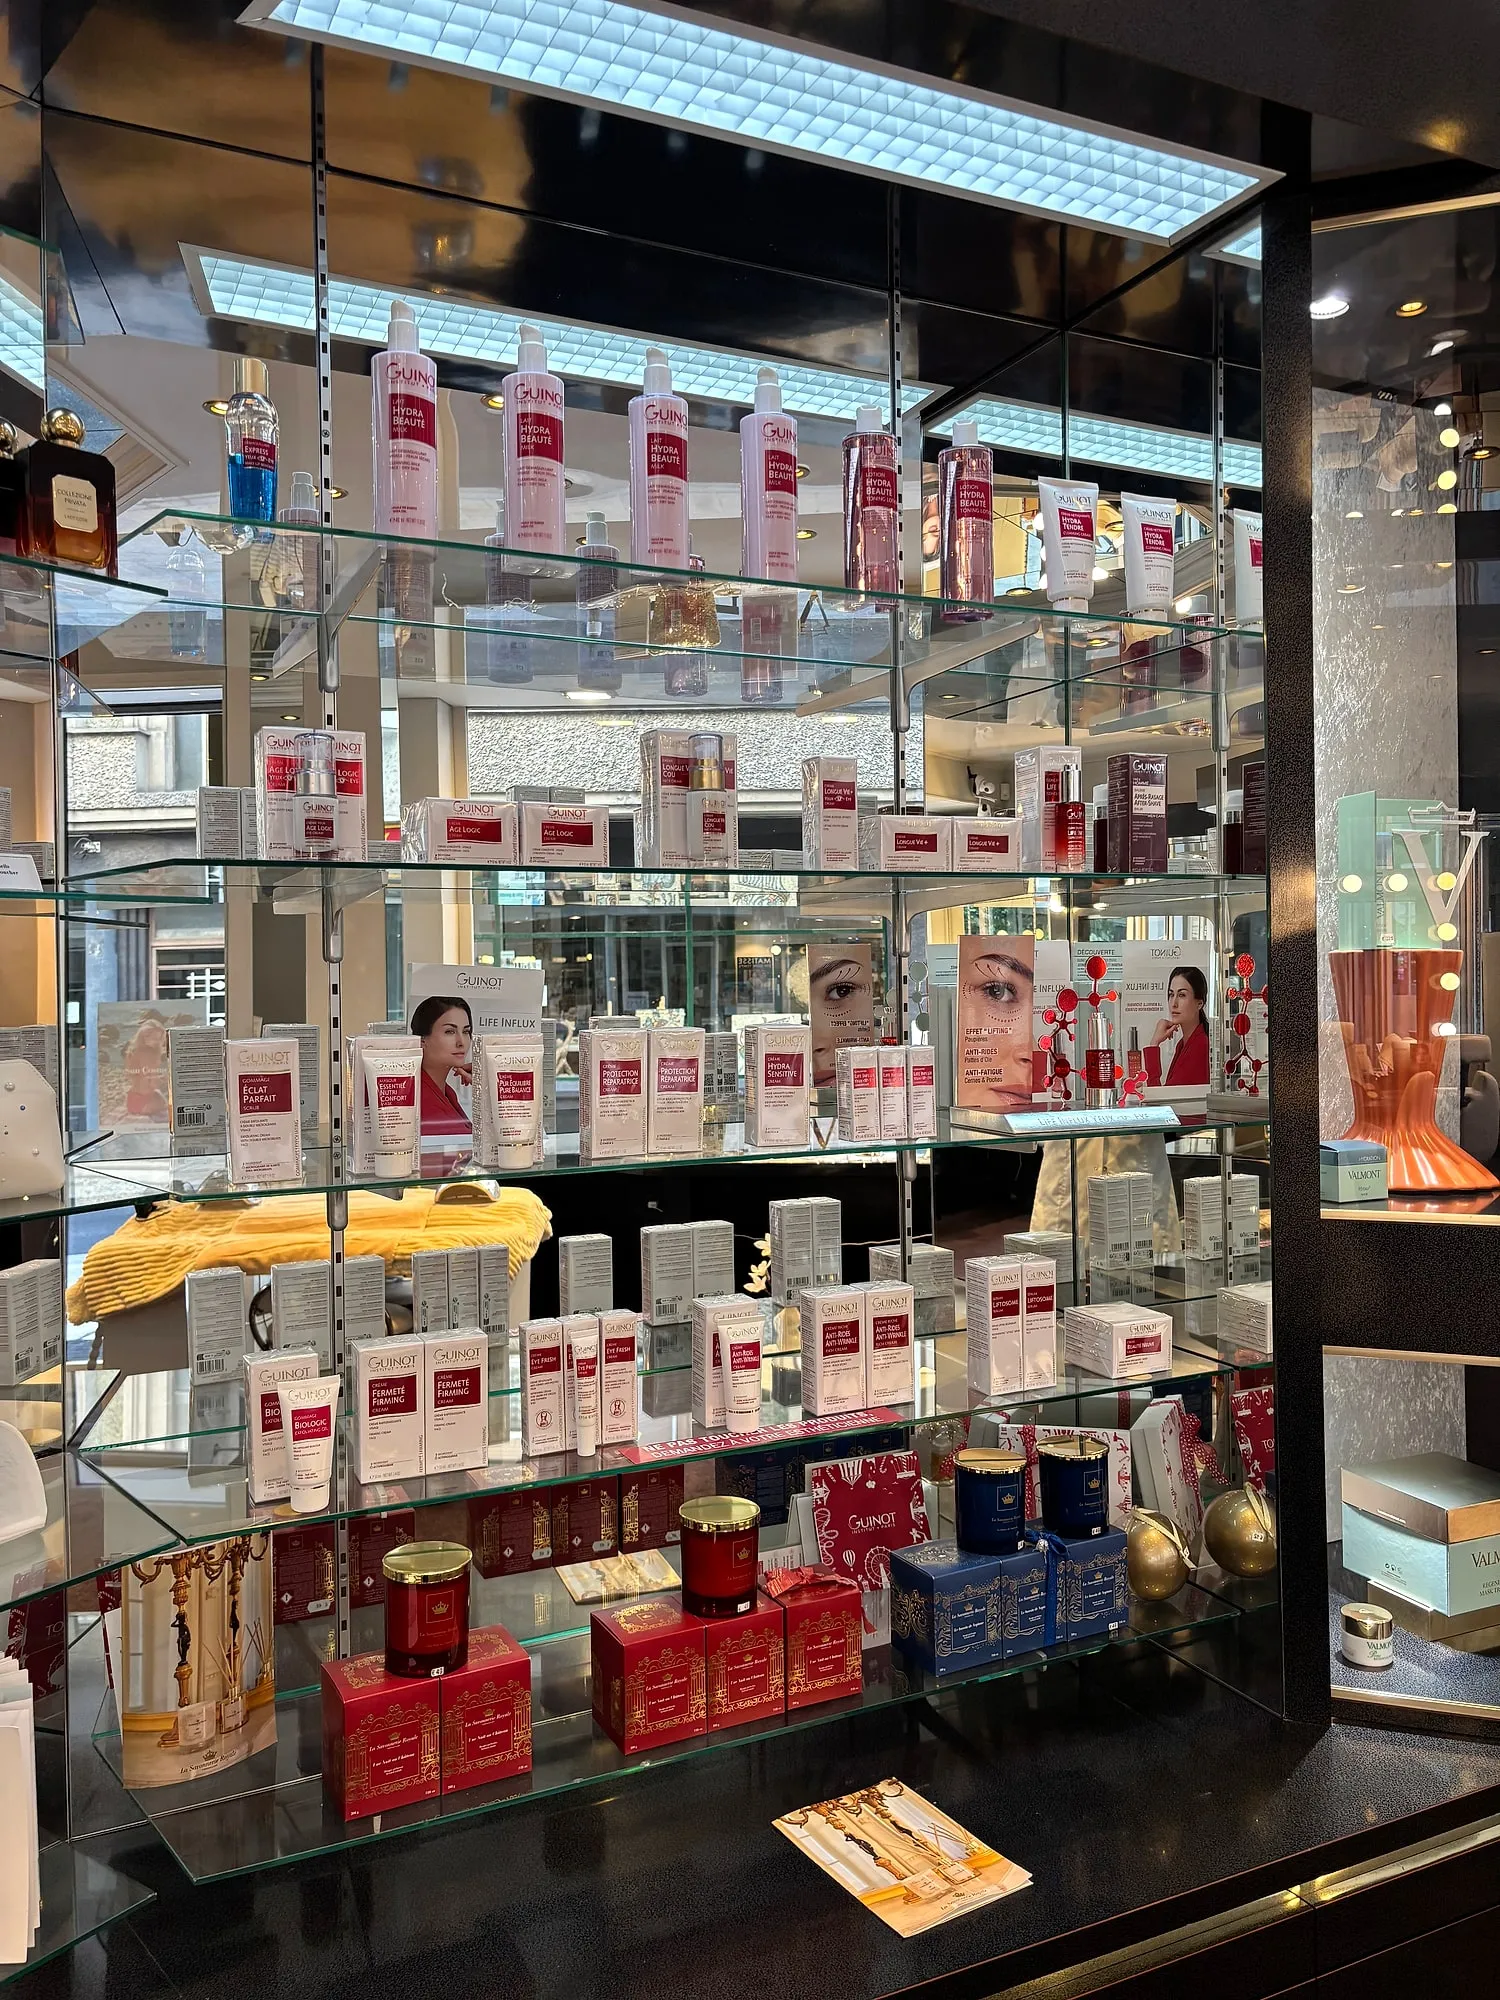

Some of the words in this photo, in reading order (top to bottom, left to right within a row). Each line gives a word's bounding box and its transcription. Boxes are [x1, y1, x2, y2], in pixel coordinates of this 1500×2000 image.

[393, 406, 424, 418] HYDRA
[393, 416, 425, 429] BEAUTÉ
[520, 425, 550, 435] HYDRA
[520, 434, 552, 445] BEAUTÉ
[244, 445, 269, 456] EXPRESS
[651, 445, 678, 455] HYDRA
[651, 453, 680, 465] BEAUTÉ
[768, 461, 793, 472] HYDRA
[866, 478, 891, 488] HYDRA
[960, 490, 985, 499] HYDRA
[64, 498, 86, 507] PRIVATA
[1062, 517, 1082, 525] HYDRA
[1062, 524, 1084, 532] TENDRE
[1145, 538, 1165, 547] TENDRE
[1132, 760, 1165, 772] GUINOT
[662, 770, 676, 778] COU
[303, 801, 334, 811] GUINOT
[452, 800, 495, 814] GUINOT
[547, 805, 587, 819] GUINOT
[988, 840, 996, 848] VIE
[1376, 871, 1385, 918] VALMONT
[456, 972, 504, 987] GUINOT
[479, 1016, 498, 1027] LIFE
[501, 1017, 535, 1028] INFLUX
[238, 1050, 291, 1063] GUINOT
[495, 1055, 535, 1066] GUINOT
[603, 1070, 639, 1078] PROTECTION
[661, 1067, 696, 1075] PROTECTION
[768, 1069, 797, 1077] SENSITIVE
[965, 1068, 1003, 1076] ANTI-FATIGUE
[603, 1077, 639, 1086] RÉPARATRICE
[661, 1075, 696, 1083] RÉPARATRICE
[243, 1084, 267, 1094] ÉCLAT
[511, 1085, 531, 1093] BALANCE
[243, 1095, 277, 1104] PARFAIT
[1038, 1118, 1056, 1126] LIFE
[1347, 1169, 1381, 1180] VALMONT
[991, 1273, 1019, 1284] GUINOT
[1026, 1269, 1054, 1281] GUINOT
[872, 1297, 908, 1309] GUINOT
[993, 1299, 1019, 1308] LIFTOSOME
[1027, 1295, 1053, 1303] LIFTOSOME
[822, 1302, 858, 1315] GUINOT
[605, 1322, 636, 1333] GUINOT
[875, 1324, 900, 1333] ANTI-RIDES
[1129, 1323, 1157, 1334] GUINOT
[528, 1331, 560, 1342] GUINOT
[825, 1331, 850, 1339] ANTI-RIDES
[875, 1331, 907, 1341] ANTI-WRINKLE
[825, 1337, 858, 1347] ANTI-WRINKLE
[434, 1347, 481, 1361] GUINOT
[368, 1355, 417, 1369] GUINOT
[541, 1356, 557, 1364] FRESH
[732, 1355, 760, 1364] ANTI-WRINKLE
[260, 1367, 311, 1383] GUINOT
[437, 1378, 470, 1389] FERMETÉ
[288, 1388, 331, 1402] GUINOT
[372, 1385, 406, 1397] FERMETÉ
[437, 1388, 470, 1398] FIRMING
[372, 1396, 405, 1407] FIRMING
[295, 1419, 327, 1429] BIOLOGIC
[644, 1443, 664, 1452] NE
[675, 1438, 697, 1448] PAS
[769, 1423, 797, 1432] LES
[651, 1441, 729, 1459] DEMANDEZ
[740, 1432, 785, 1444] VOTRE
[785, 1415, 883, 1438] ESTHÉTICIENNE
[848, 1511, 896, 1530] GUINOT
[851, 1526, 875, 1534] INSTITUT
[472, 1716, 496, 1726] Savonnerie
[376, 1740, 401, 1750] Savonnerie
[190, 1759, 219, 1771] Savonnerie
